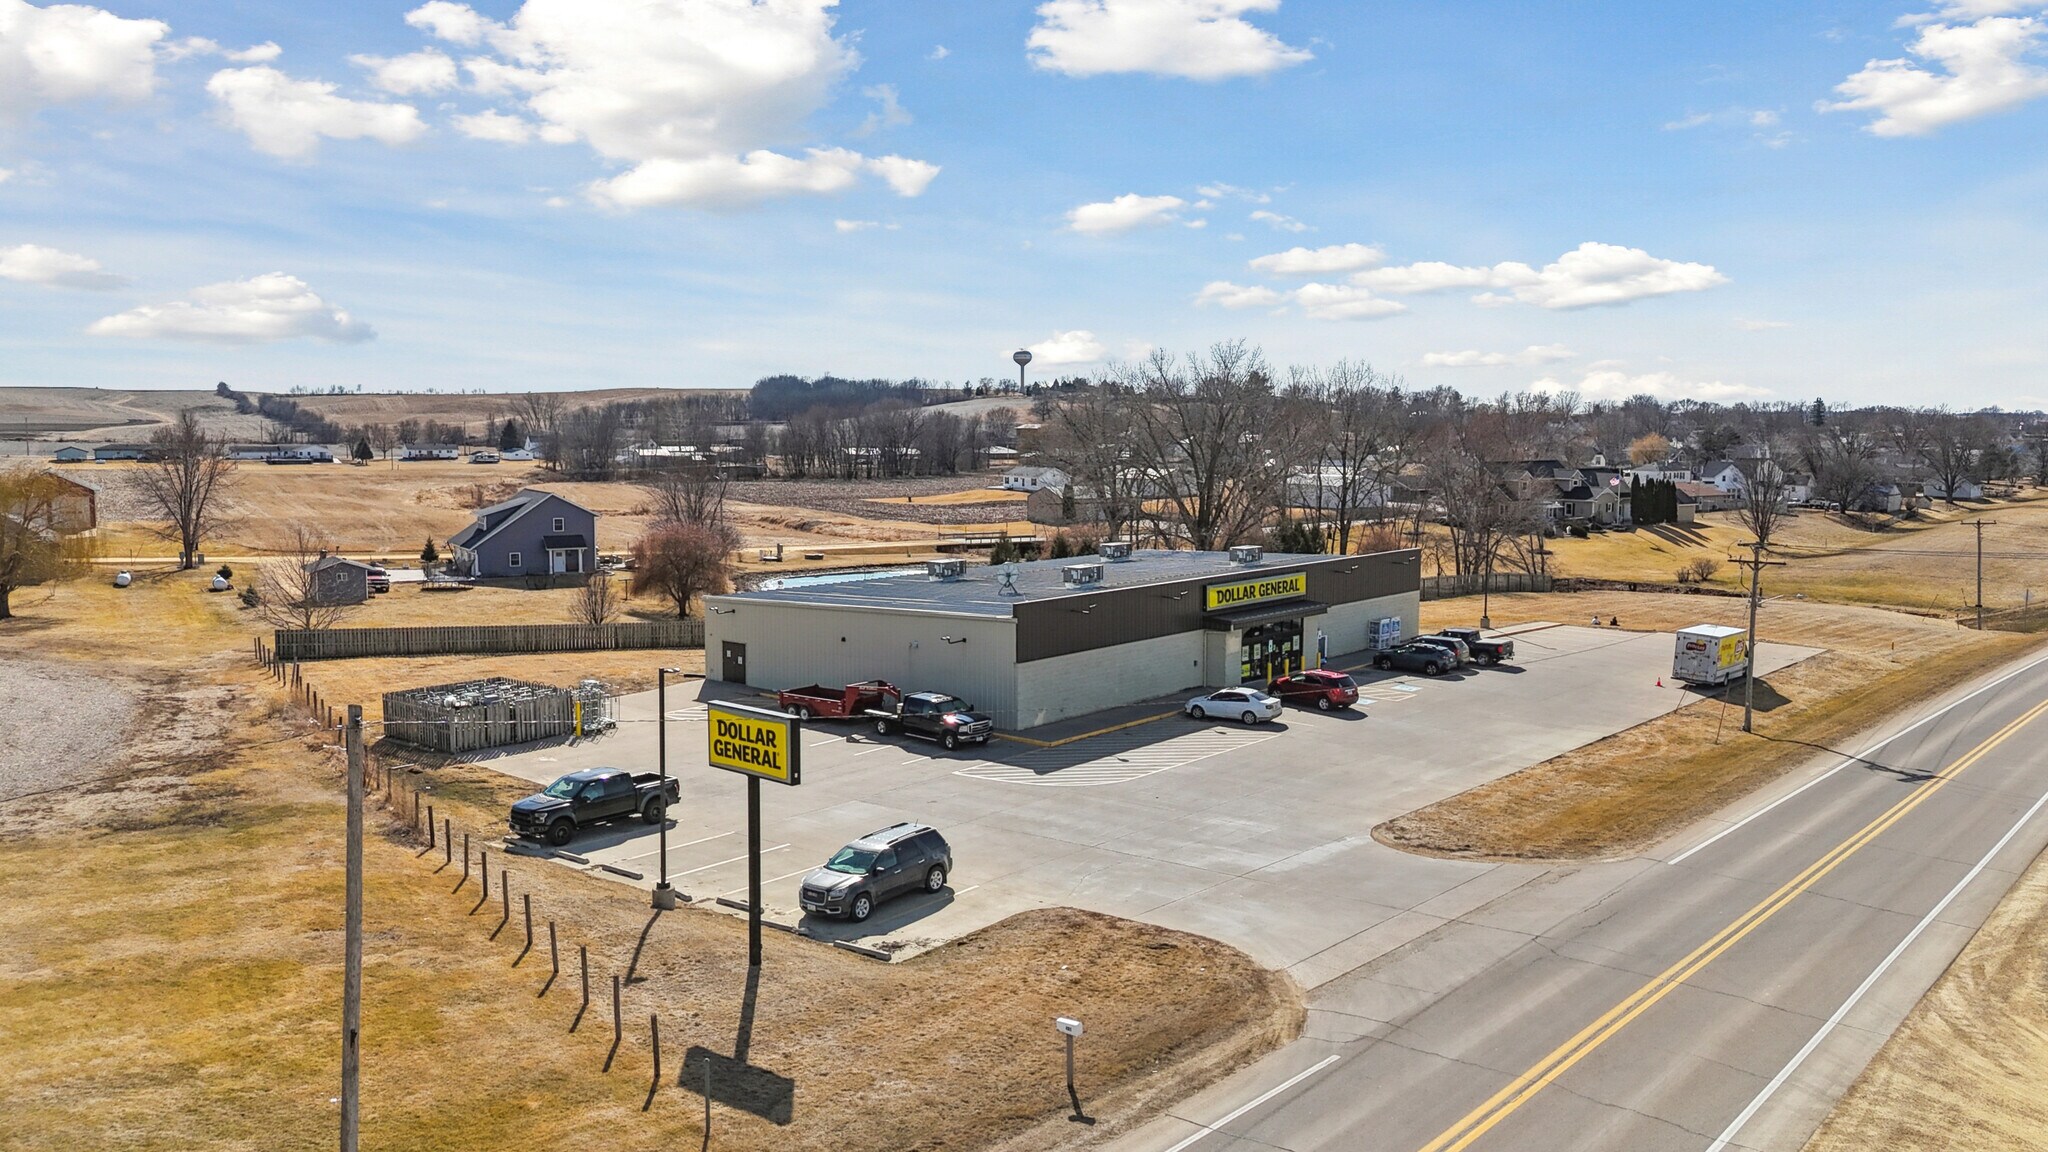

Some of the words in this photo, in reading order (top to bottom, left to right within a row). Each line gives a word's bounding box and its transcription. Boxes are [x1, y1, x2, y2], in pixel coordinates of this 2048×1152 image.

[1216, 585, 1256, 604] DOLLAR
[1258, 578, 1300, 597] GENERAL
[716, 719, 777, 749] DOLLAR
[713, 739, 782, 770] GENERAL
